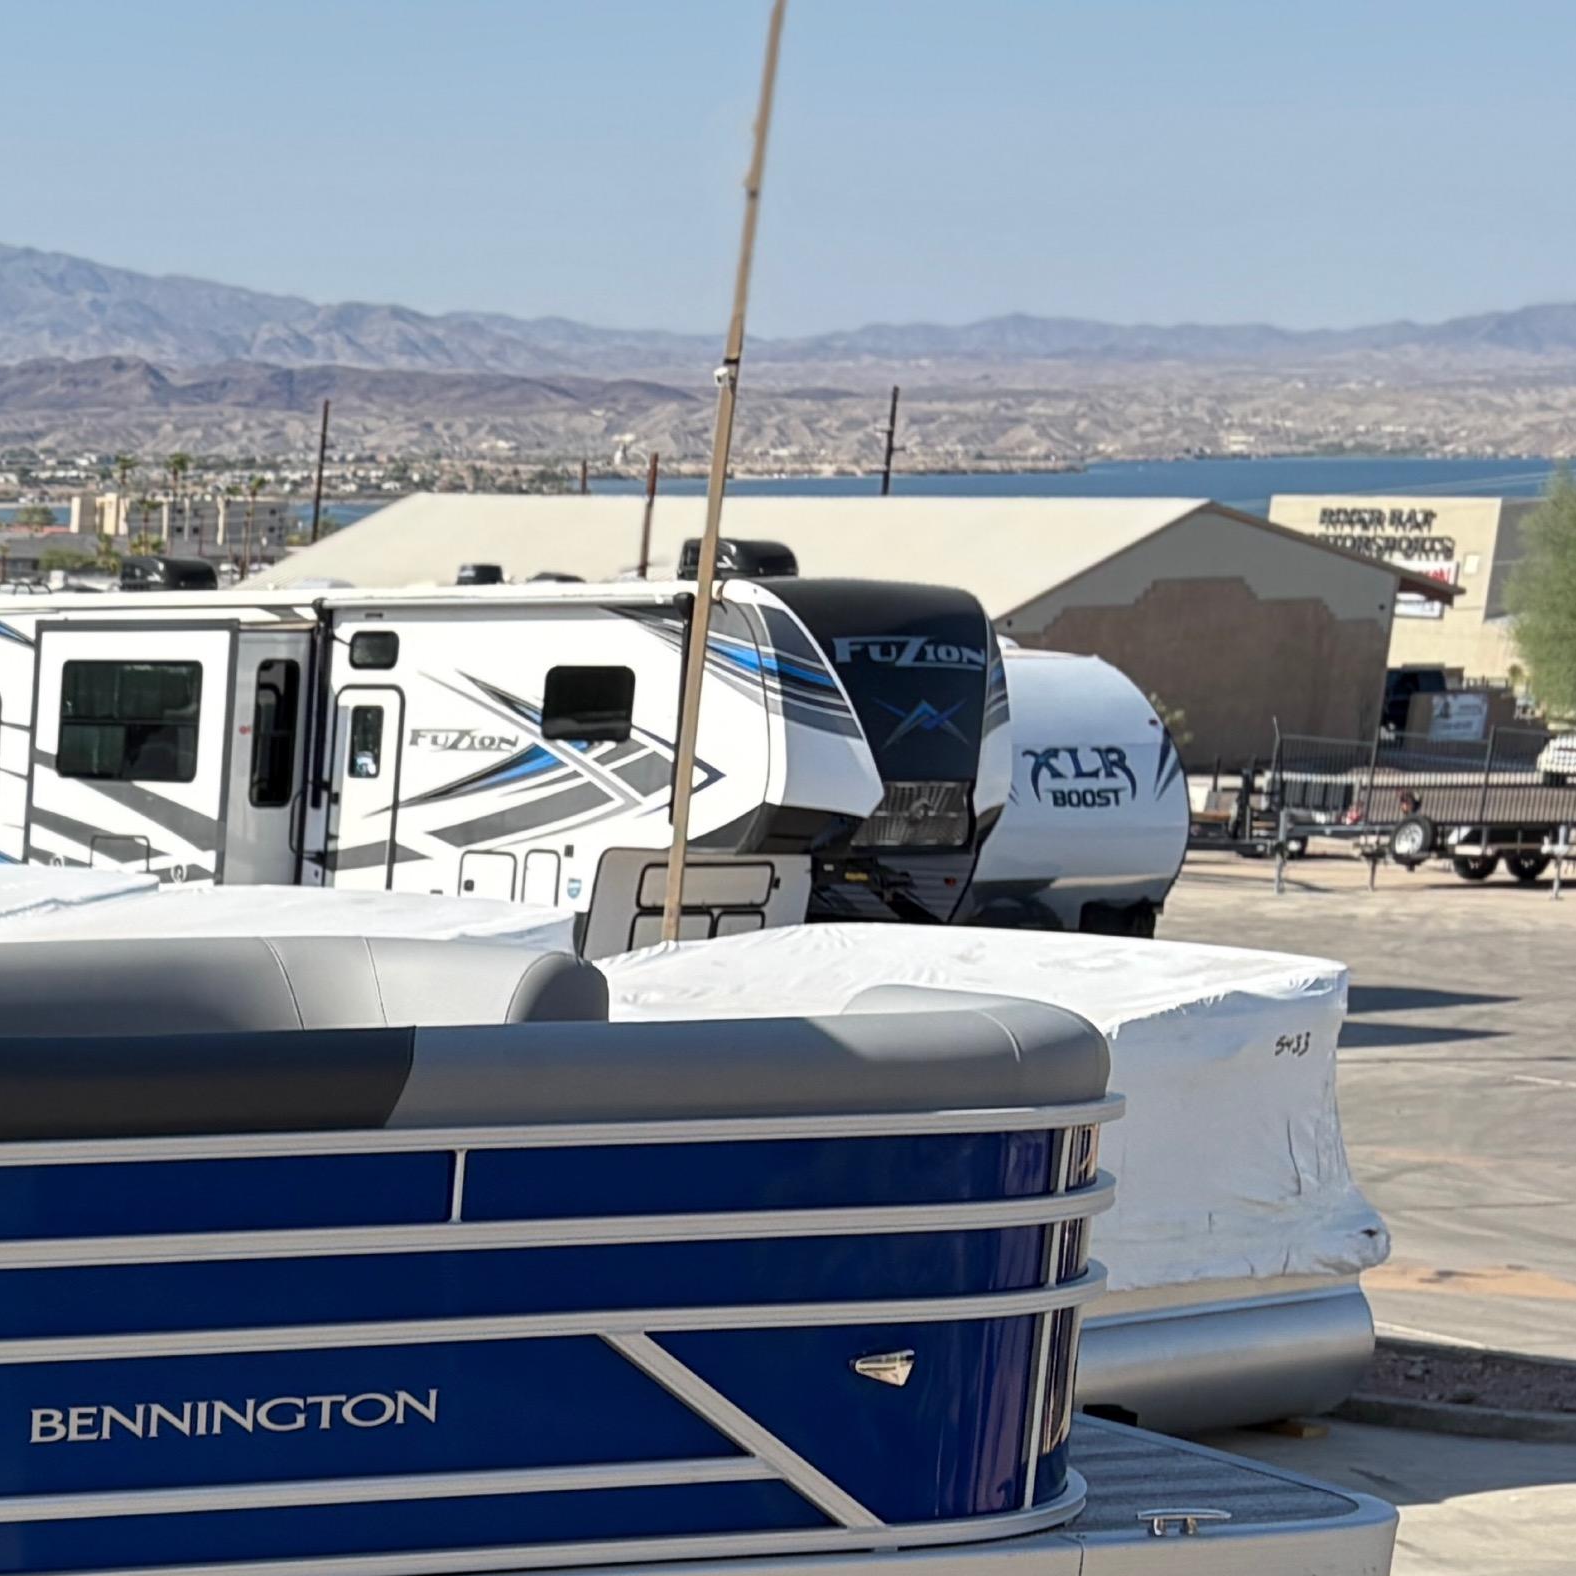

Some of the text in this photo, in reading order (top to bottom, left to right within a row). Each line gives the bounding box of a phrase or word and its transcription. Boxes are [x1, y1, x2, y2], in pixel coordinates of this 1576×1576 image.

[831, 635, 986, 671] FUZION
[1021, 746, 1136, 802] XLR
[1052, 788, 1121, 808] BOOST
[29, 1388, 438, 1444] BENNINGTON
